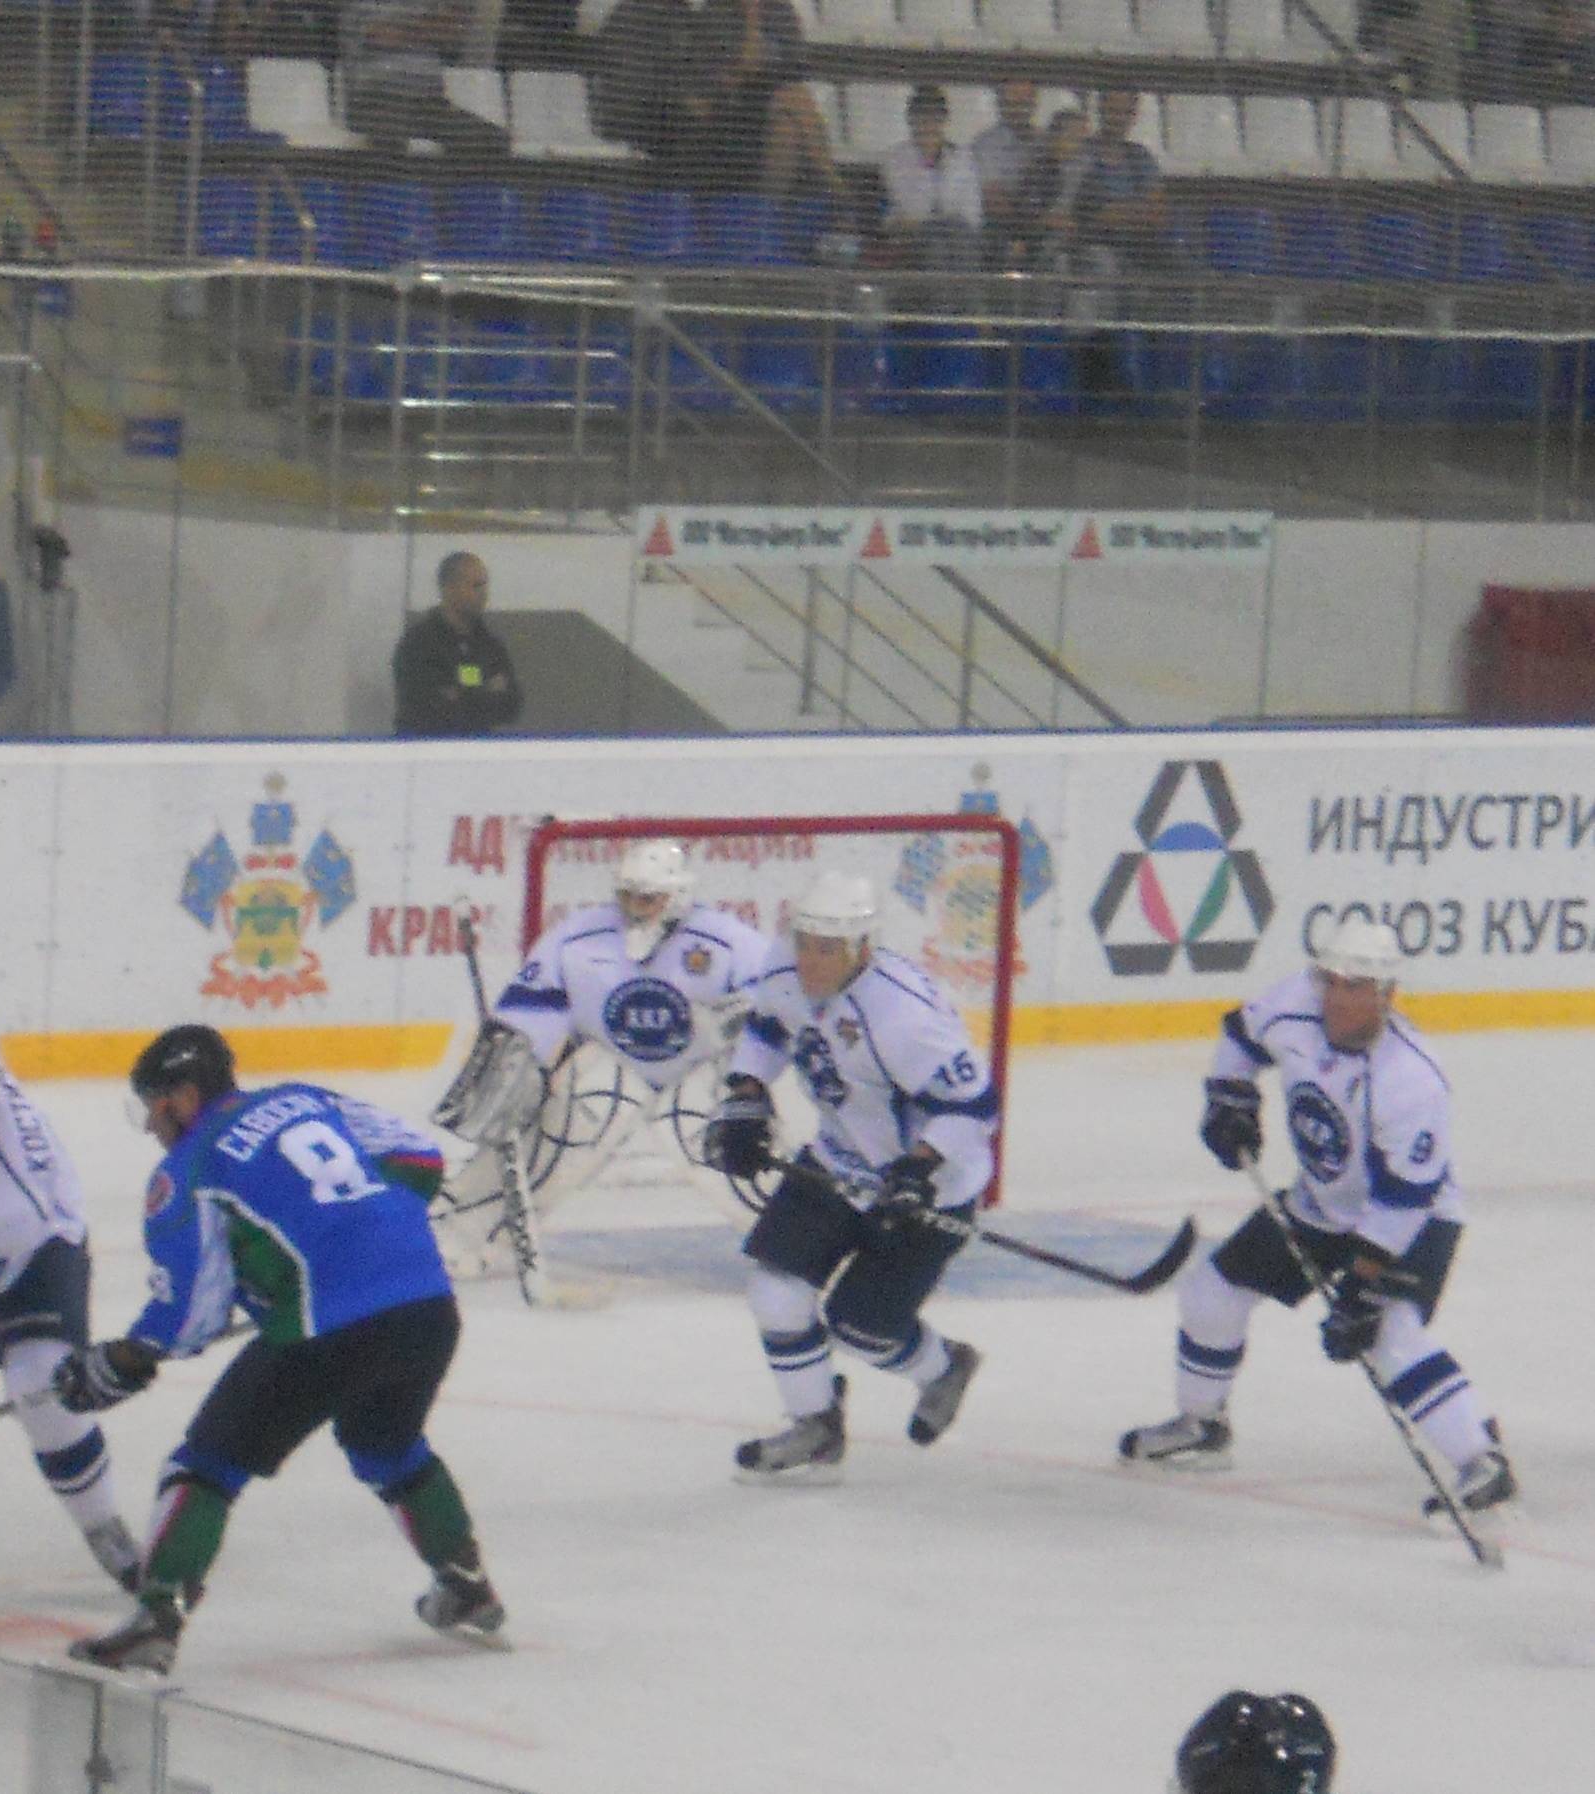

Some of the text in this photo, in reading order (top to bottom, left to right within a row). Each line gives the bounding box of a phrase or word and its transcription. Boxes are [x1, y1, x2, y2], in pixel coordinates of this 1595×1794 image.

[1308, 795, 1595, 866] ИНДУСТРИ
[1480, 897, 1595, 955] КУБ
[278, 1119, 386, 1204] 8
